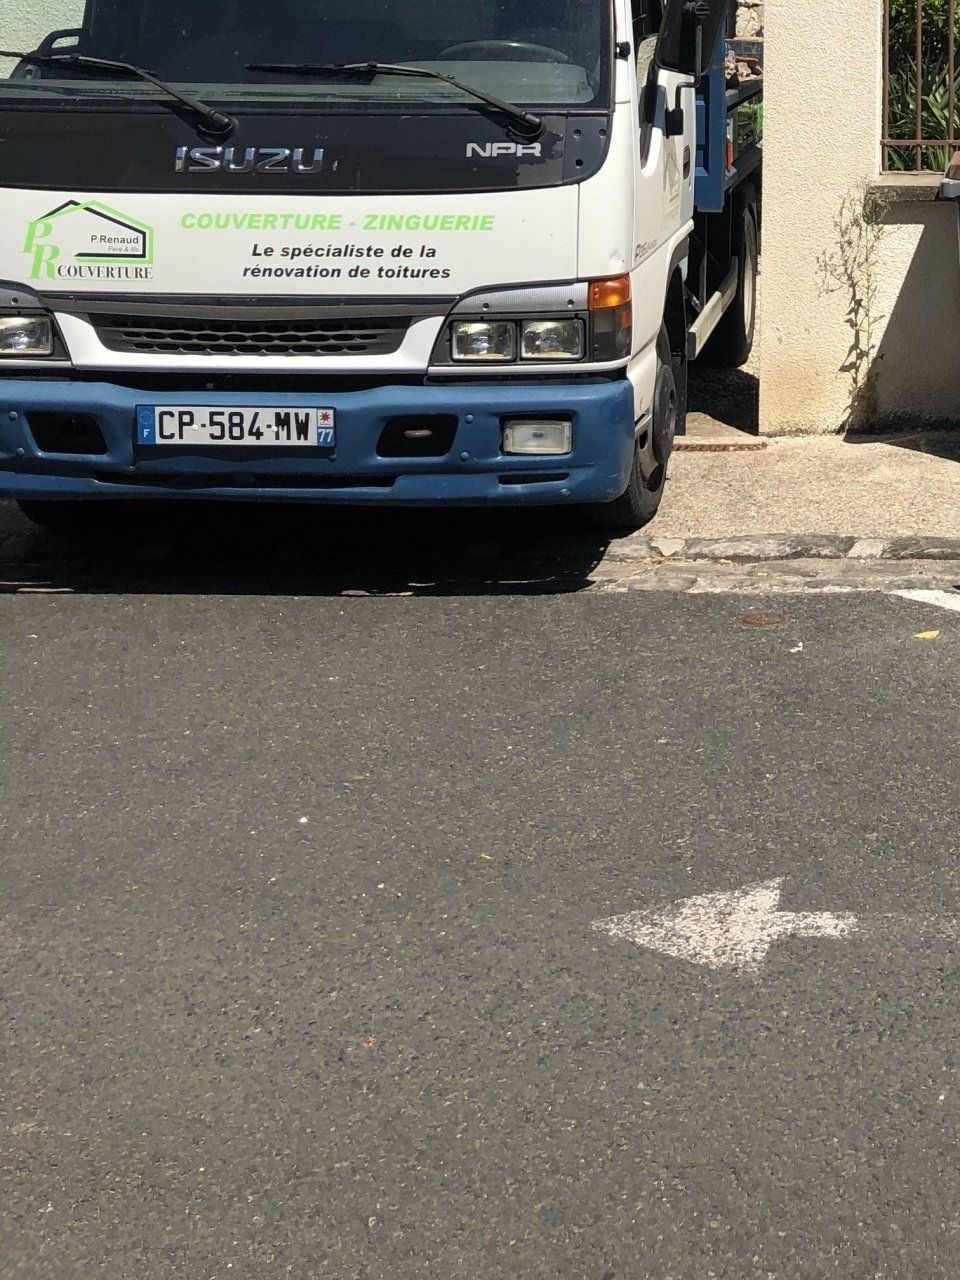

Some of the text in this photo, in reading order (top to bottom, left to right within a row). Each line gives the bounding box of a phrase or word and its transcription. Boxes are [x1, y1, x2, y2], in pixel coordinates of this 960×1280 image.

[465, 142, 542, 157] NPR
[174, 146, 324, 174] ISUZU
[180, 213, 496, 231] COUVERTURE ZINGUERIE
[90, 234, 139, 245] P.Renaud
[251, 243, 437, 260] Le spécialiste de la
[57, 264, 154, 280] COUVERTURE
[242, 264, 451, 279] rénovation de toitures
[143, 428, 150, 438] F
[158, 410, 310, 442] CP-584-MW
[317, 428, 334, 443] 77
